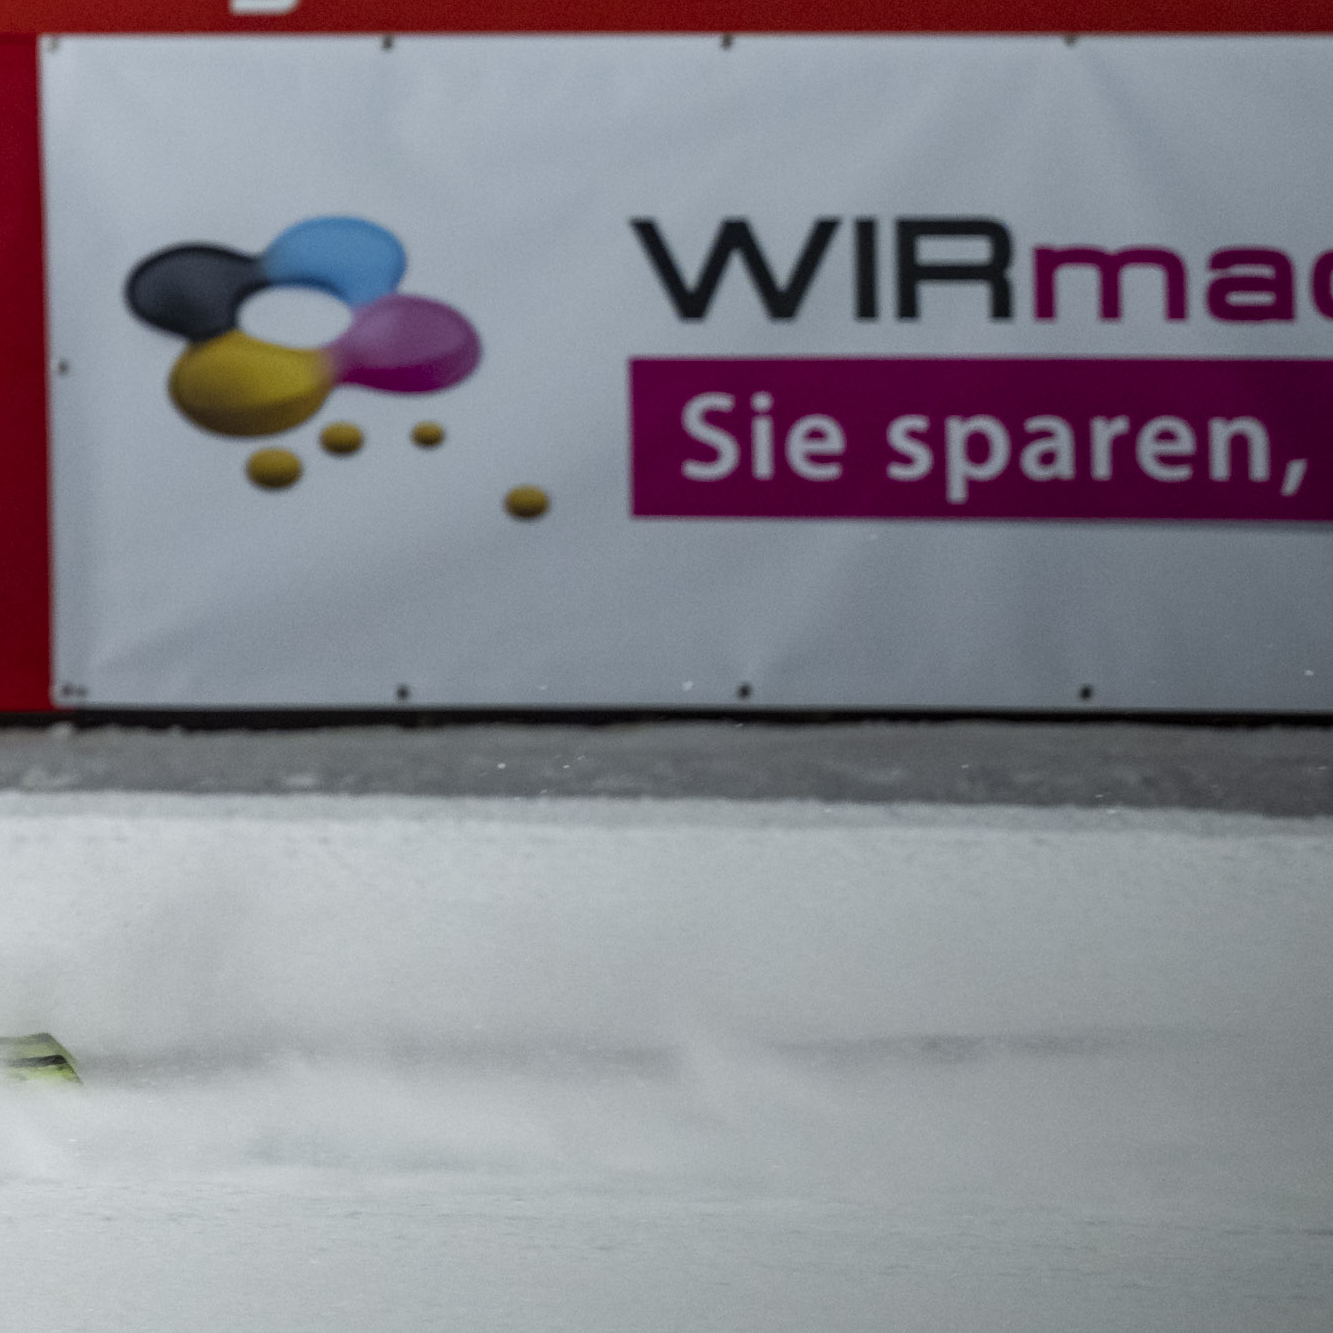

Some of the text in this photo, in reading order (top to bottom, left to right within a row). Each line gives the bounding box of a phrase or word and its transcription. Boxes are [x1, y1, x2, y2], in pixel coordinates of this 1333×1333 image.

[628, 215, 1333, 323] WIRma
[680, 390, 1309, 505] Sie sparen,
